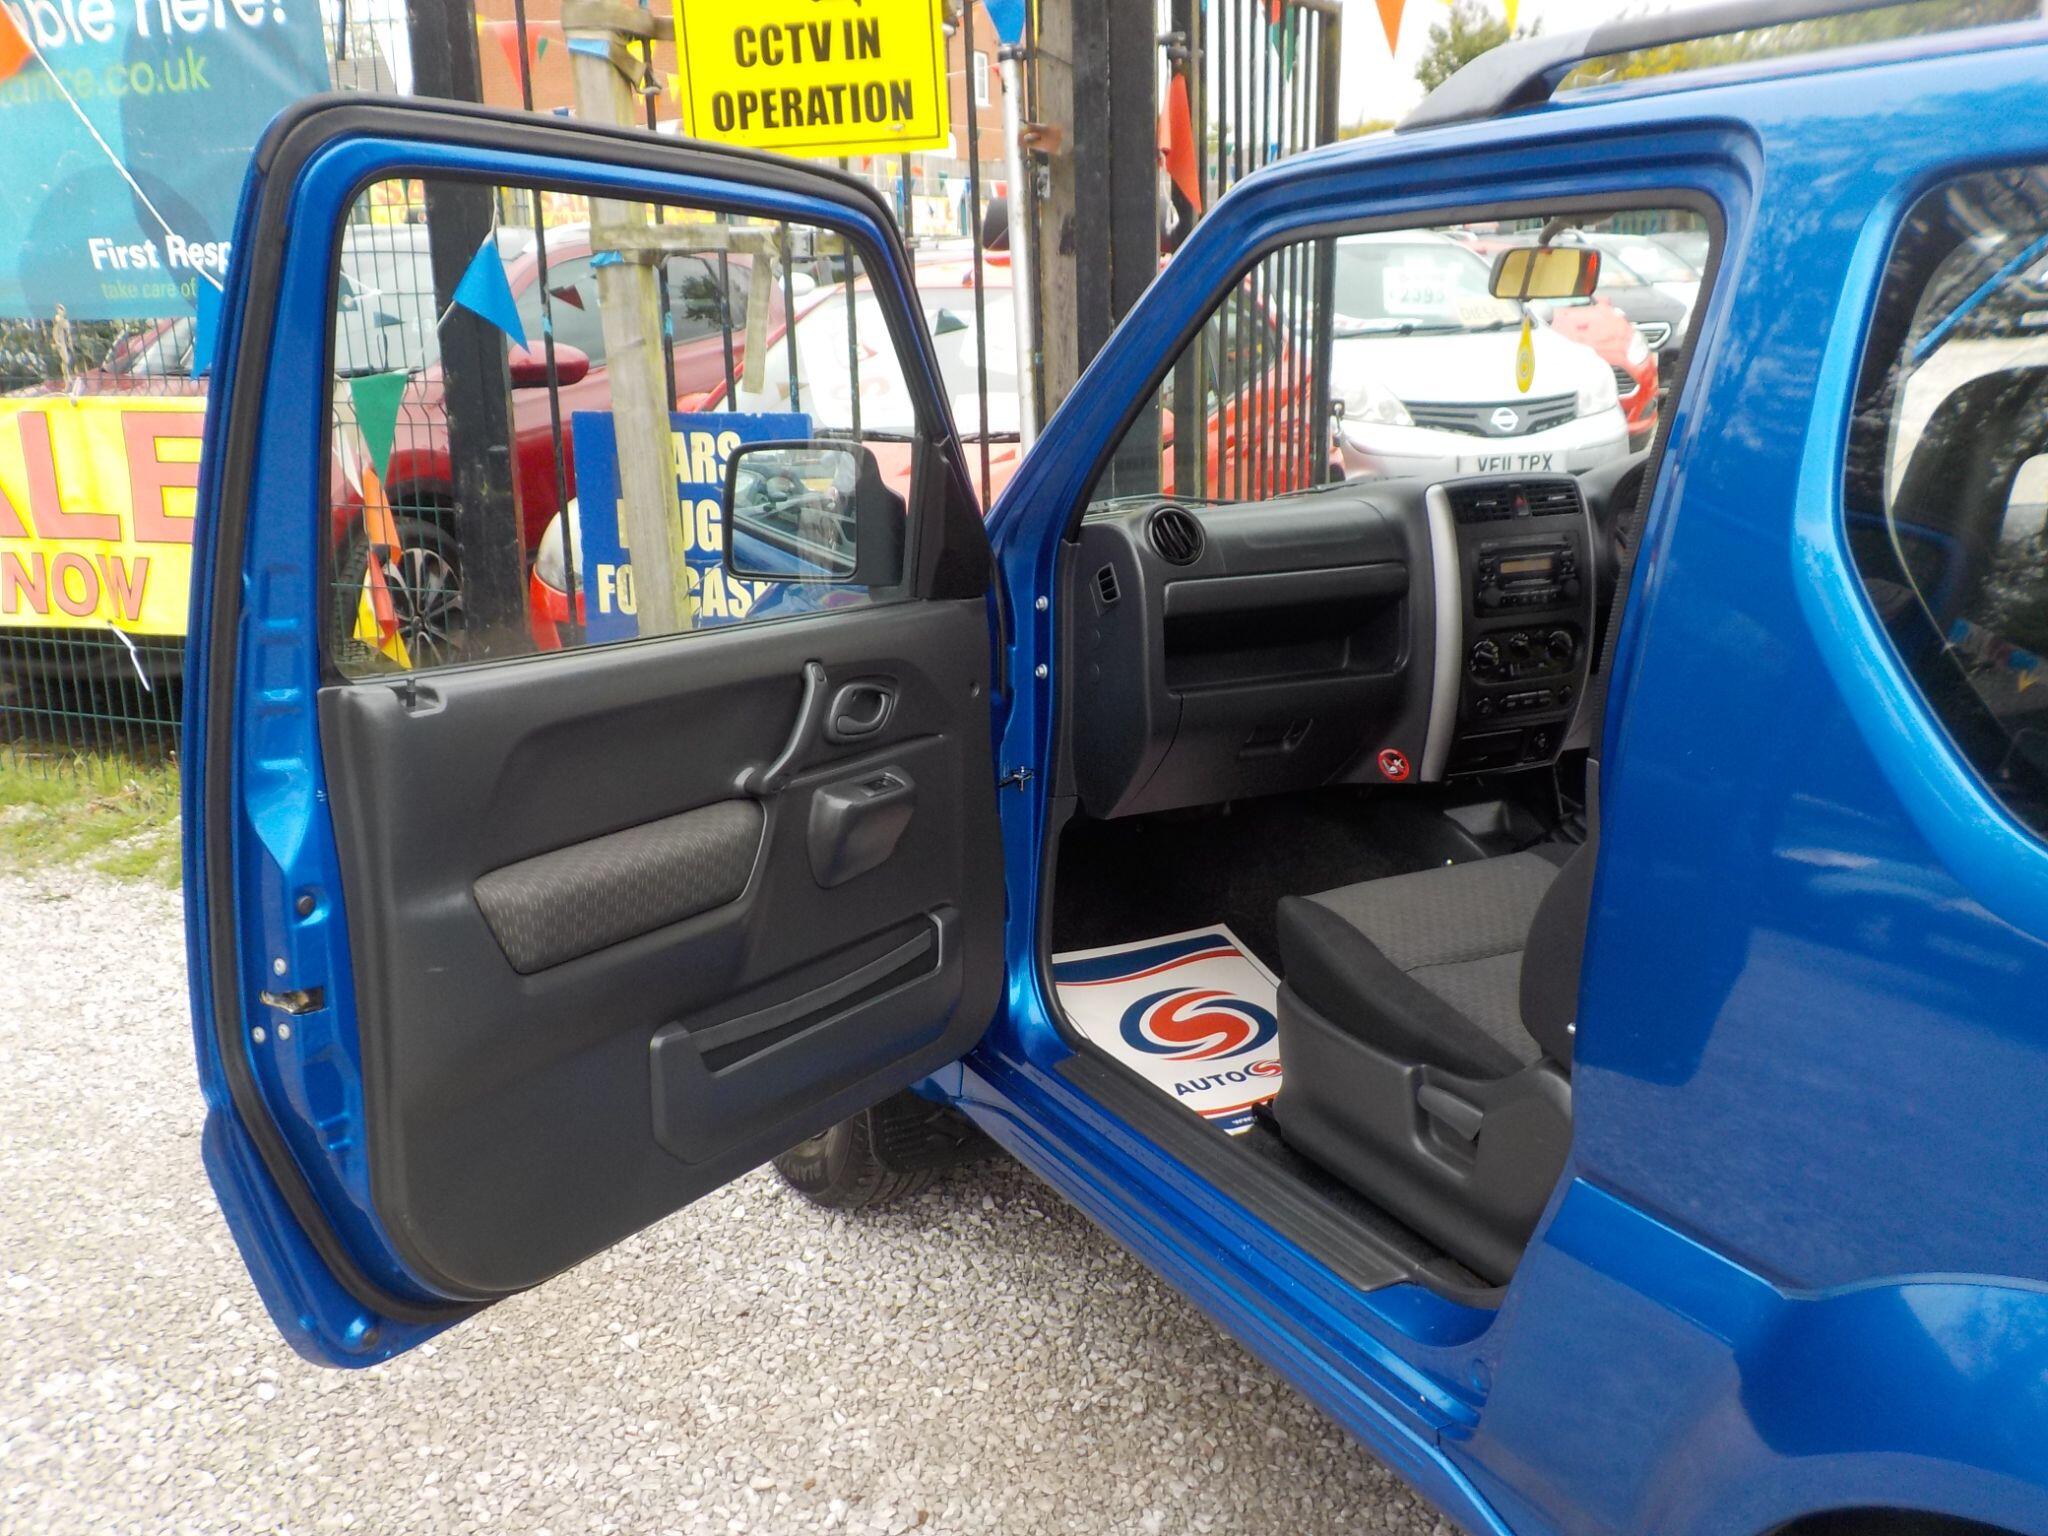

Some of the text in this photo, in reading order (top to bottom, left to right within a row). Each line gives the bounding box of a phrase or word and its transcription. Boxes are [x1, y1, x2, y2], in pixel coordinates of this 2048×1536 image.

[733, 16, 881, 68] CCTV IN
[711, 79, 914, 132] OPERATION
[88, 237, 160, 270] First
[101, 278, 197, 299] take care of
[0, 411, 207, 544] LE
[671, 431, 741, 483] ARS
[1517, 452, 1553, 471] TPX
[1, 552, 150, 621] NOW
[597, 564, 772, 618] FO CAS
